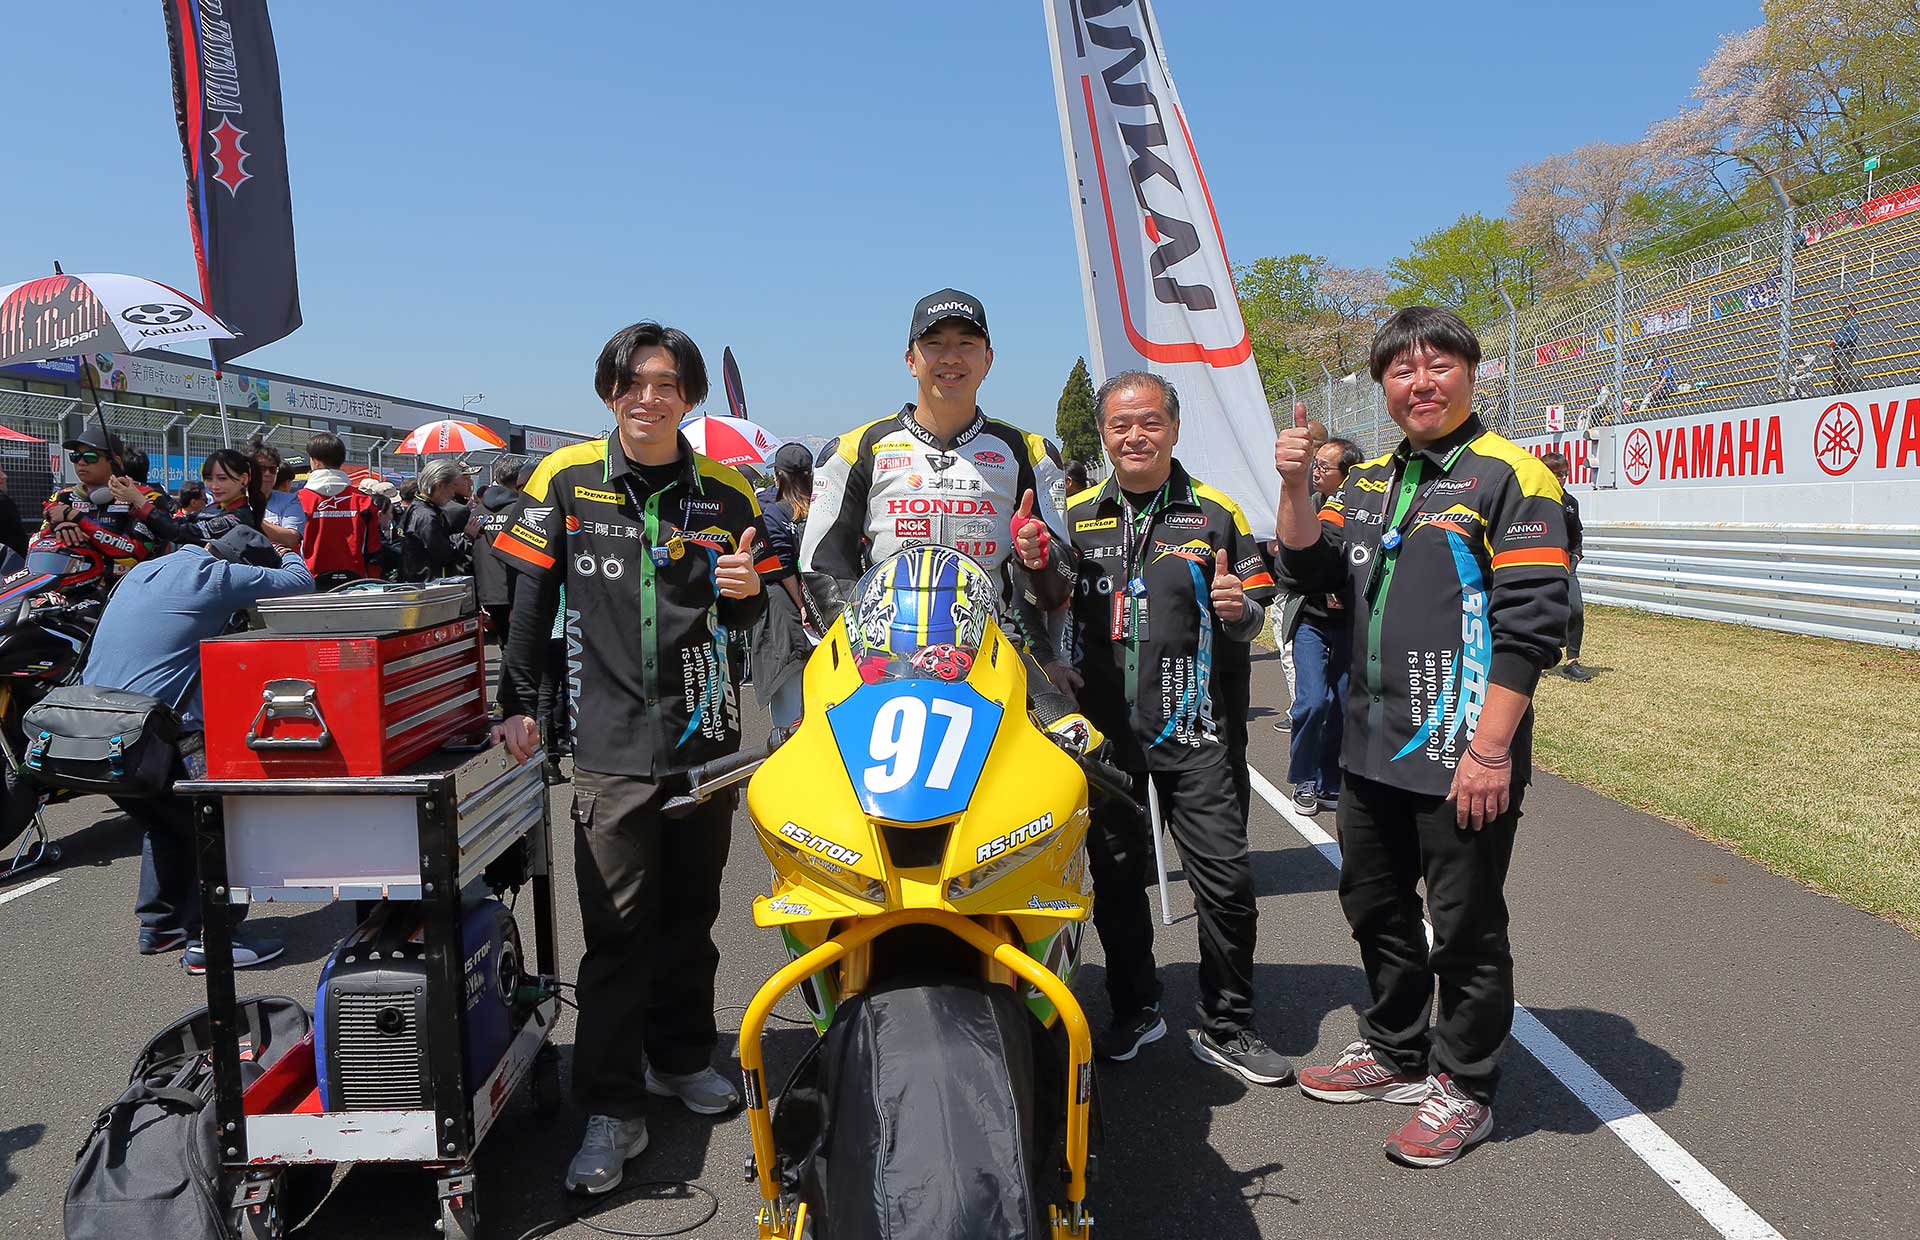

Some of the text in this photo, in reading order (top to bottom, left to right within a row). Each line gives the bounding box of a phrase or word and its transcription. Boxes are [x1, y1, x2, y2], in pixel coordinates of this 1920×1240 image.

[1080, 0, 1218, 312] NKAI
[927, 301, 974, 315] NANKAI
[50, 329, 98, 351] Japan
[138, 324, 207, 338] Kabuto
[299, 391, 382, 419] 大成ロテック株式会社
[902, 415, 934, 444] NANKAI
[956, 416, 983, 445] NANKAI
[1655, 415, 1785, 480] YAMAHA
[718, 455, 754, 465] ONDA
[877, 457, 910, 469] SPRINTA
[974, 461, 1005, 470] Kabuto
[583, 491, 623, 502] DUNLOP
[886, 499, 998, 515] HONDA
[517, 516, 548, 536] HONDA
[584, 521, 641, 539] 三陽工業
[897, 519, 927, 531] NGK
[1084, 519, 1114, 529] DUNLOP
[1168, 516, 1204, 525] NANKAI
[93, 529, 135, 552] aprilia
[520, 530, 545, 544] DUNLOP
[1154, 543, 1211, 556] RS-ITOH
[4, 568, 29, 584] WRS
[682, 647, 695, 713] rs-itoh.com
[702, 641, 725, 741] nankaibuhin.co.jp
[1162, 657, 1171, 719] rs-itoh.com
[1407, 650, 1422, 727] rs-itoh.com
[692, 646, 714, 739] sanyou-ind.co.jp
[1175, 658, 1187, 745] sanyou-ind.co.jp
[1423, 651, 1441, 761] sanyou-ind.co.jp
[1441, 649, 1459, 769] nankaibuhin.co.jp
[863, 696, 973, 794] 97
[779, 821, 862, 866] RS-ITOH
[976, 813, 1053, 864] RS-ITOH
